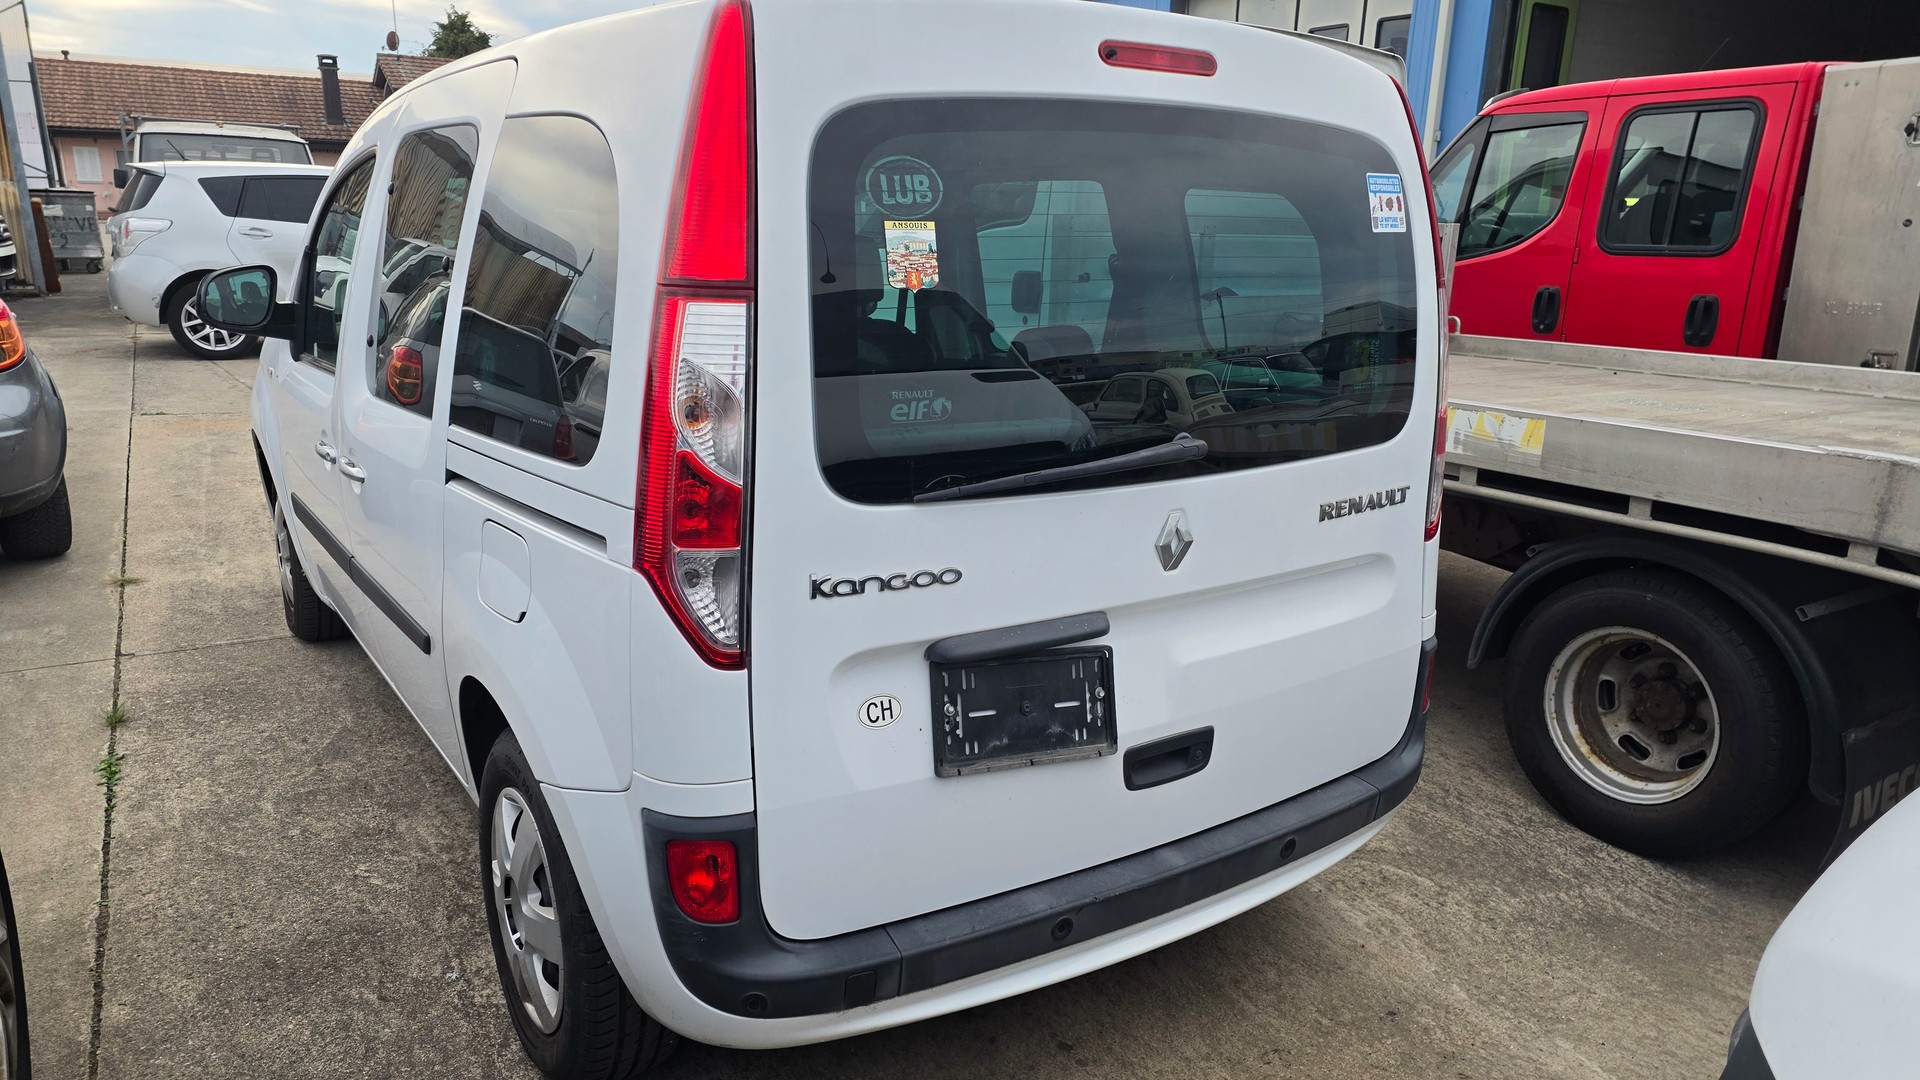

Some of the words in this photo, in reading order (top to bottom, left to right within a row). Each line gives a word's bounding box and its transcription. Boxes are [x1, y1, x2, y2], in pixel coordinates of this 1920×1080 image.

[879, 174, 933, 205] LUB
[892, 389, 935, 399] RENAULT
[890, 400, 930, 421] elf
[1318, 485, 1411, 523] RENAULT
[866, 698, 894, 724] CH
[1848, 762, 1920, 829] IVEC
